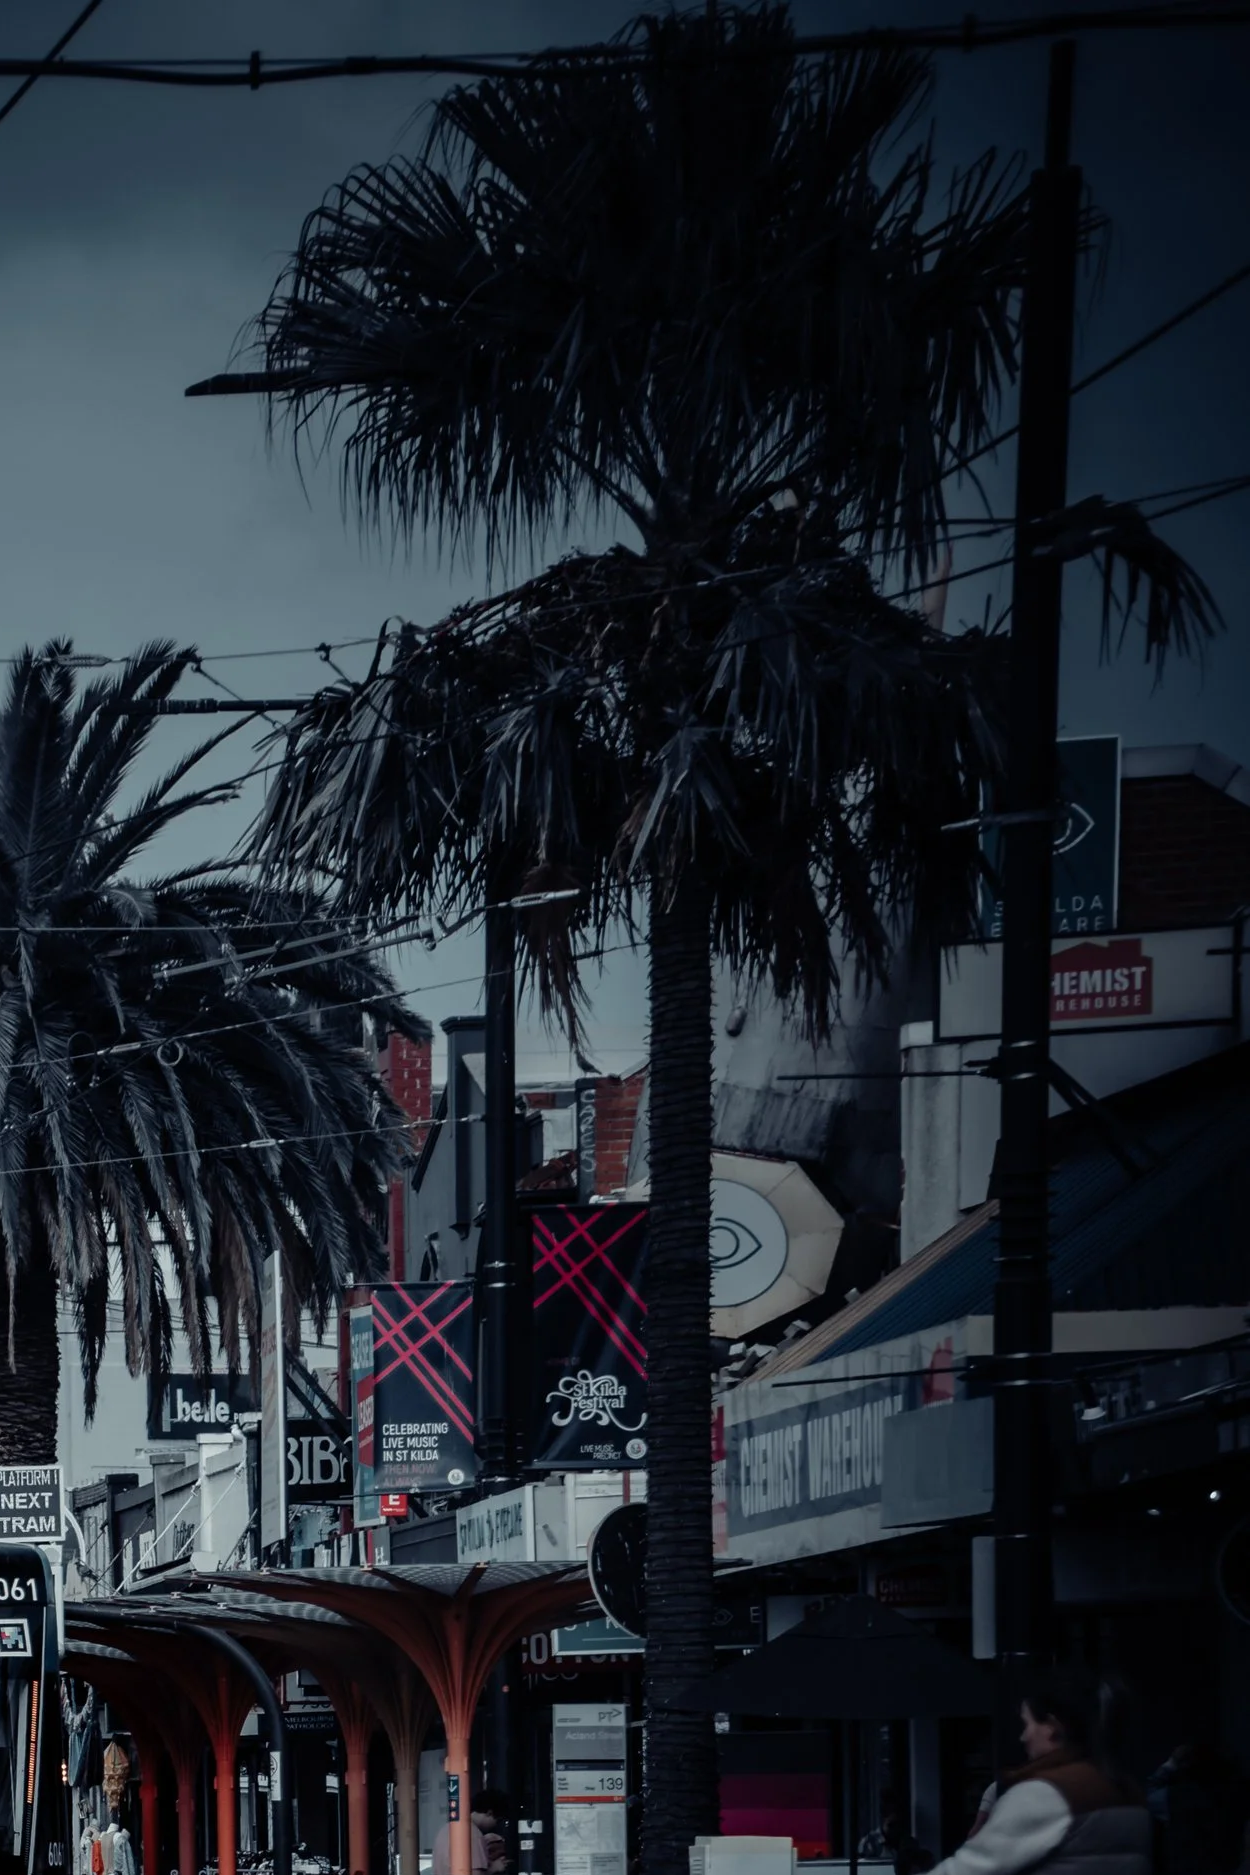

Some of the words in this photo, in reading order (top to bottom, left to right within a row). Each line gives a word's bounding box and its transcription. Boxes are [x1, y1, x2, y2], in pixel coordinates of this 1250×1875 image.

[1055, 994, 1142, 1013] REHOUSE
[176, 1388, 230, 1423] belle
[382, 1422, 449, 1436] CELEBRATING
[382, 1437, 404, 1449] LIVE
[407, 1436, 439, 1448] MUSIC
[382, 1451, 393, 1462] IN
[395, 1451, 408, 1462] ST
[410, 1449, 439, 1461] KILDA
[740, 1424, 803, 1518] CHEMIST
[807, 1394, 903, 1501] WAREHOU
[0, 1492, 53, 1510] NEXT
[0, 1515, 56, 1534] TRAM
[598, 1777, 624, 1791] 139
